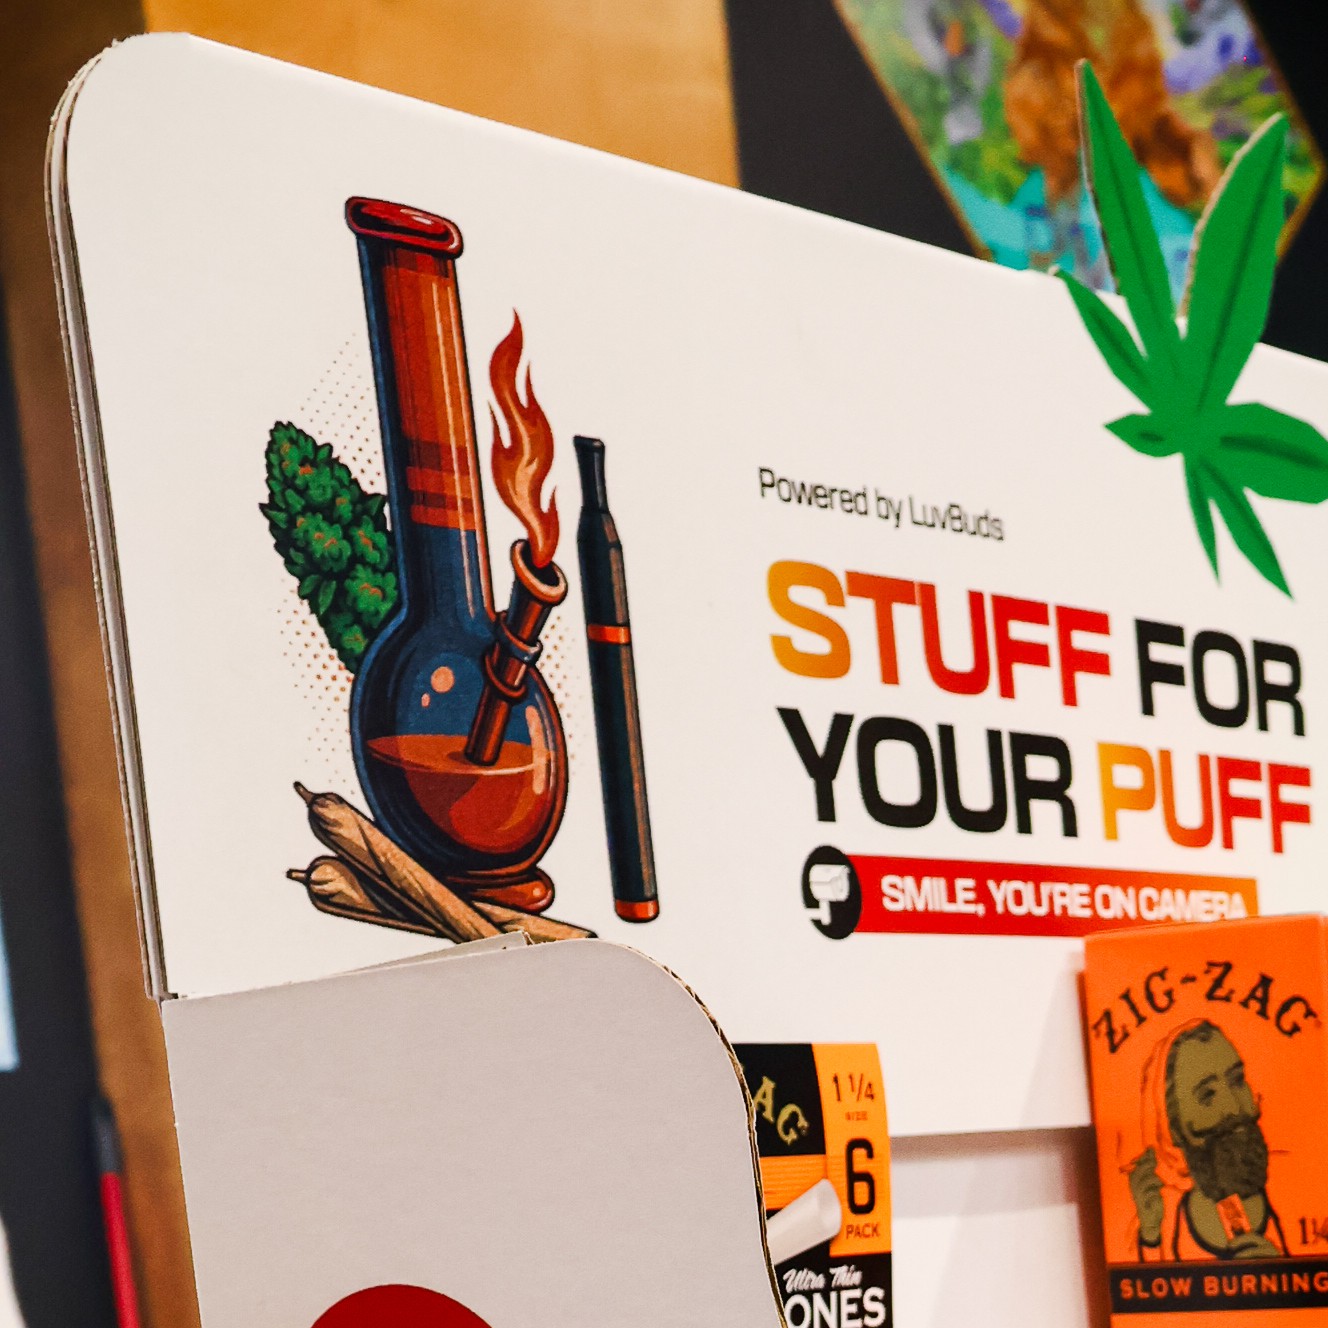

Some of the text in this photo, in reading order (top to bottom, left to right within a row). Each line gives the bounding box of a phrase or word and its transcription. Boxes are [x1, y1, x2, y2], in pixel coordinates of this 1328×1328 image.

[759, 467, 1004, 541] Powered by LuvBuds
[767, 559, 1305, 736] STUFF FOR
[776, 707, 1311, 853] YOUR PUFF
[881, 875, 1248, 922] SMILE, YOU'RE ON CAMERA
[1092, 960, 1320, 1055] ZIG-ZAG
[845, 1137, 876, 1215] 6
[846, 1222, 880, 1241] PACK
[783, 1264, 863, 1294] Ultra Thin
[1120, 1277, 1192, 1300] SLOW
